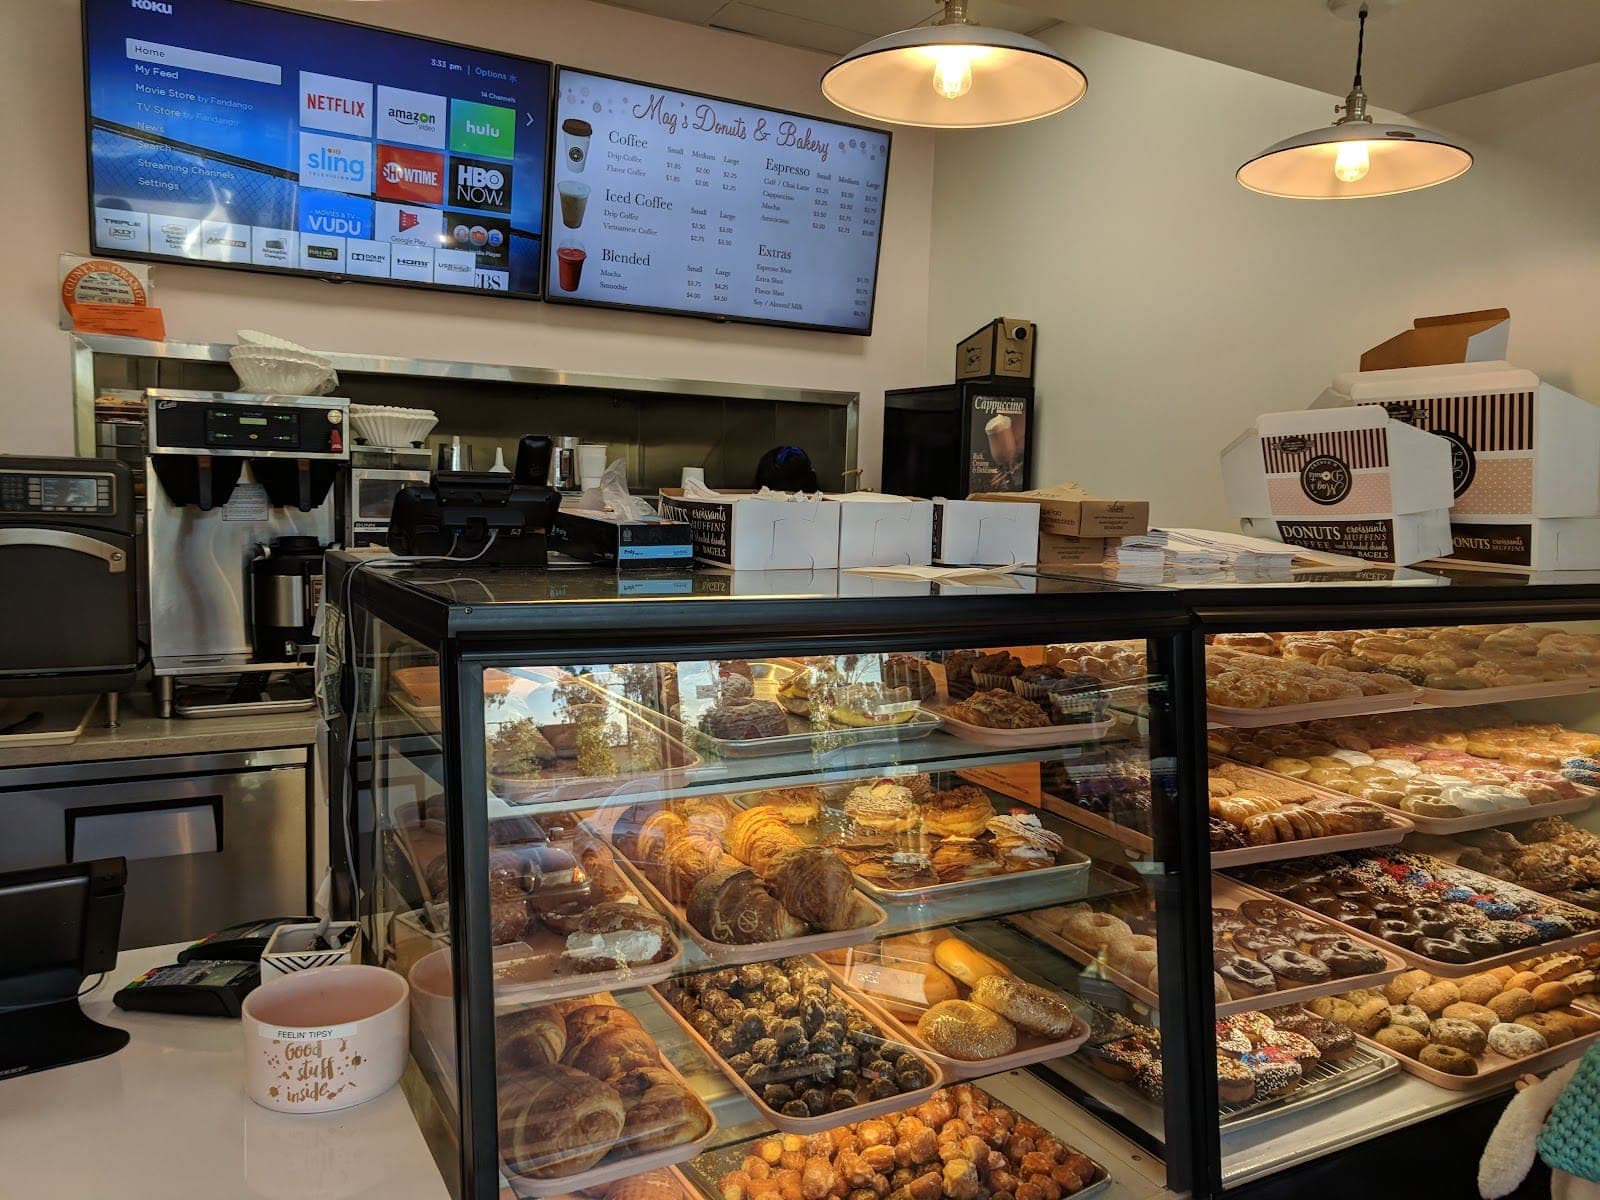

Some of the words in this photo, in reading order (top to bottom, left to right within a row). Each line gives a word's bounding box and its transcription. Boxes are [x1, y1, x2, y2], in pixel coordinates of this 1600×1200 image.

[134, 45, 166, 59] Home
[134, 64, 151, 77] My
[153, 67, 179, 80] Feed
[430, 58, 447, 69] 3:33
[449, 63, 462, 73] pm
[475, 67, 508, 81] Options
[135, 83, 166, 97] Movie
[168, 89, 196, 102] Store
[198, 95, 210, 105] by
[210, 97, 254, 112] Fandango
[488, 92, 517, 104] Channels
[136, 102, 151, 113] TV
[153, 106, 182, 118] Store
[306, 93, 366, 119] NETFLIX
[387, 106, 436, 125] amazon
[136, 120, 166, 133] News
[417, 123, 436, 133] video
[465, 120, 500, 139] hulu
[632, 94, 689, 135] Mag's
[692, 104, 747, 140] Donuts
[753, 118, 771, 142] &
[776, 121, 830, 162] Bakery
[136, 140, 173, 153] Search
[608, 130, 648, 149] Coffee
[607, 151, 621, 161] Drip
[622, 153, 643, 163] Coffee
[666, 146, 684, 156] Small
[691, 150, 716, 161] Medium
[723, 156, 740, 166] Large
[137, 159, 189, 176] Streaming
[191, 166, 236, 180] Channels
[307, 147, 366, 182] sling
[606, 164, 627, 175] Flavor
[626, 168, 648, 178] Coffee
[765, 157, 811, 177] Espresso
[382, 161, 438, 187] SHOWTIME
[457, 165, 505, 189] HBO
[695, 167, 711, 175] $2.00
[723, 171, 738, 180] $2.25
[137, 177, 181, 191] Settings
[865, 180, 881, 190] Large
[605, 188, 631, 205] Iced
[635, 193, 673, 211] Coffee
[314, 209, 338, 218] MOVIES
[603, 209, 618, 219] Drip
[619, 211, 640, 221] Coffee
[690, 207, 708, 216] Small
[719, 211, 736, 221] Large
[103, 218, 141, 228] TRIPLE
[307, 215, 361, 236] VUDU
[603, 222, 637, 234] Vietnamese
[638, 227, 659, 236] Coffee
[390, 235, 414, 246] Google
[413, 239, 427, 248] Play
[601, 248, 651, 267] Blended
[758, 244, 792, 261] Extras
[600, 269, 622, 278] Mocha
[686, 264, 703, 274] Small
[715, 268, 731, 278] Large
[111, 265, 146, 305] ORANGE
[599, 281, 628, 292] Smoothie
[974, 395, 1025, 415] Cappuccino
[691, 505, 727, 522] croissants
[1281, 525, 1341, 541] DONUTS
[1345, 521, 1388, 534] croissants
[1343, 533, 1388, 542] MUFFINS
[1357, 550, 1389, 559] BAGELS
[277, 1030, 307, 1040] FEELIN'
[309, 1029, 333, 1039] TIPSY
[284, 1039, 323, 1062] Good
[296, 1056, 335, 1082] stuff
